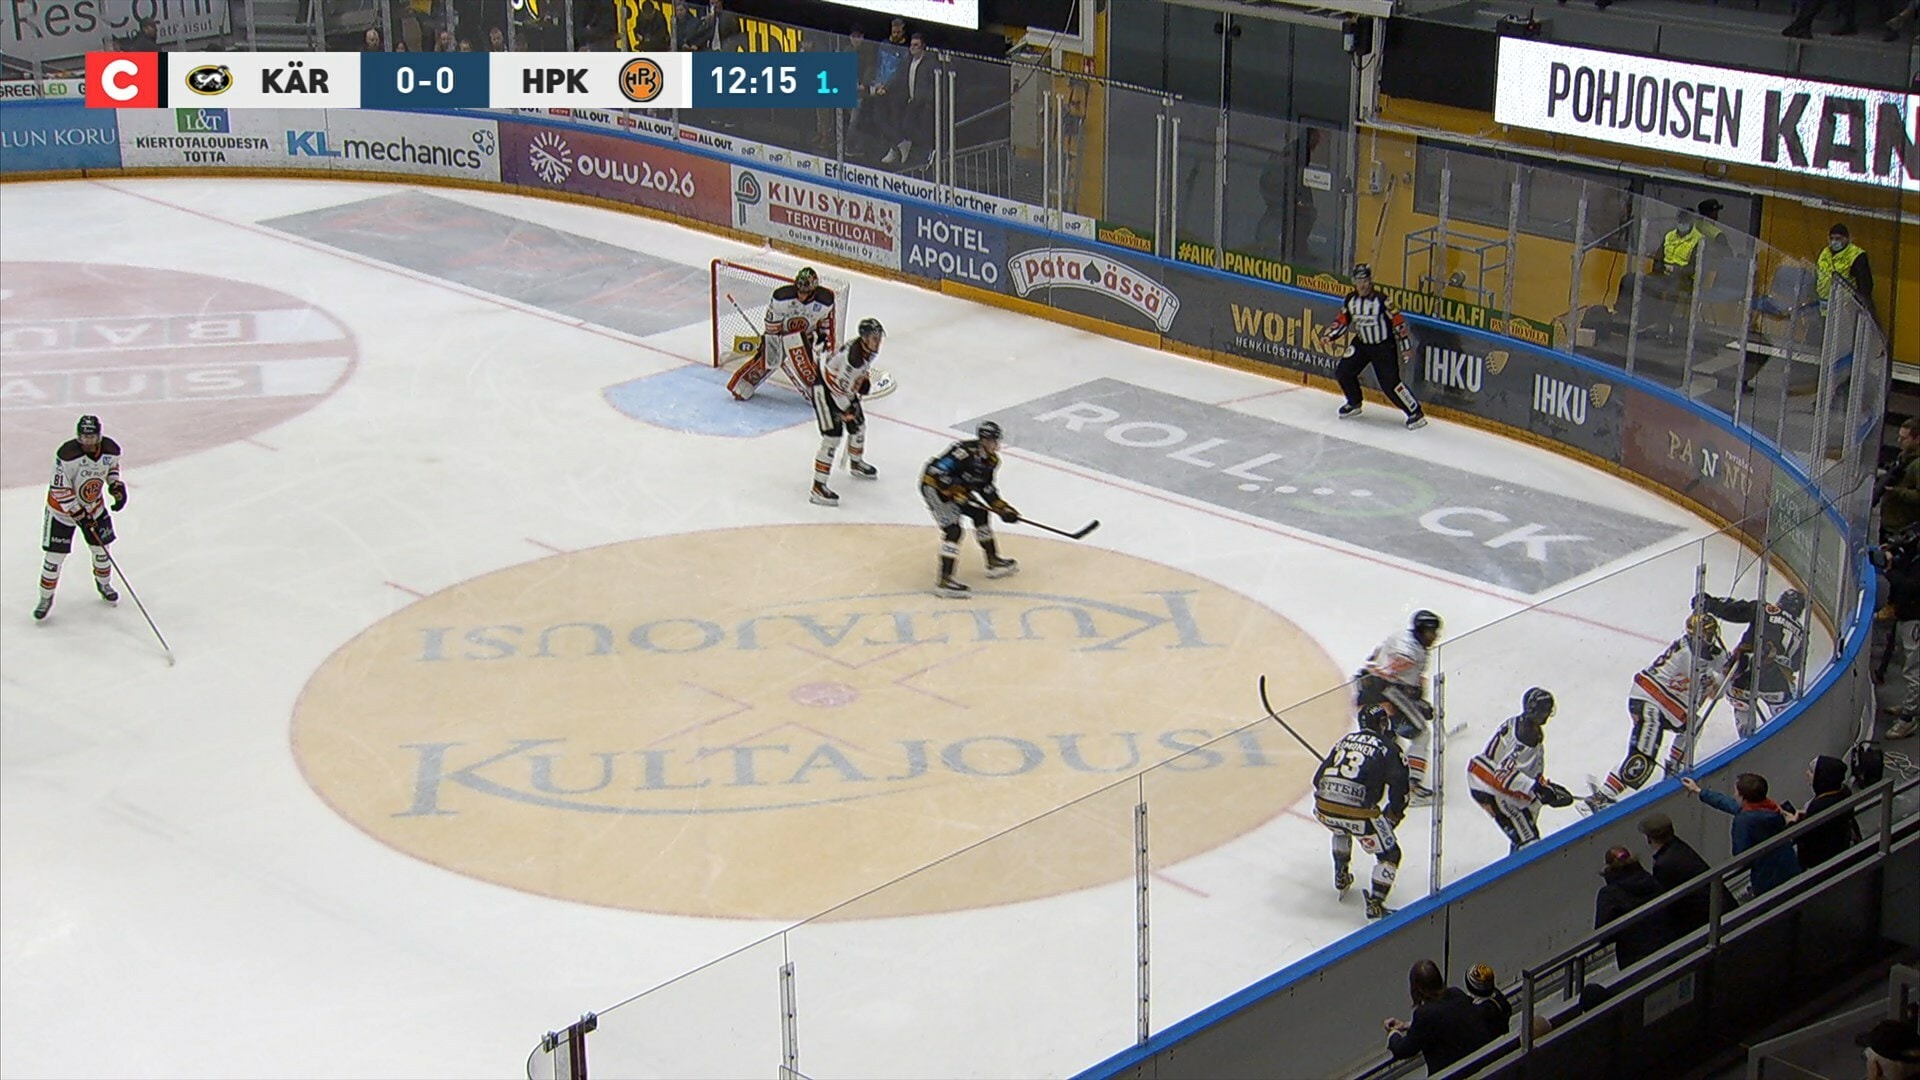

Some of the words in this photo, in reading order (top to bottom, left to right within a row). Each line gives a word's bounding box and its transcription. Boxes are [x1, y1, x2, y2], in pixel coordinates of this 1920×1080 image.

[186, 107, 221, 131] L&T
[1548, 62, 1743, 147] POHJOISEN
[1, 130, 47, 148] LUN
[54, 128, 116, 147] KORU
[136, 136, 269, 150] KIERTOTALOUDESTA
[638, 121, 653, 133] ALL
[699, 132, 714, 146] ALL
[184, 150, 226, 163] TOTTA
[768, 181, 893, 228] KIVISYDÄN
[788, 229, 813, 243] Oulun
[815, 234, 861, 257] Pysäköinti
[862, 248, 874, 260] Oy
[917, 215, 990, 255] HOTEL
[909, 244, 998, 284] APOLLO
[1025, 255, 1081, 284] pata
[1103, 264, 1160, 314] ässä
[1424, 346, 1484, 393] IHKU
[1533, 373, 1588, 425] IHKU
[417, 587, 1226, 662] KULTAJOUSI
[391, 726, 1278, 818] KULTAJOUSI
[1323, 750, 1365, 779] 23
